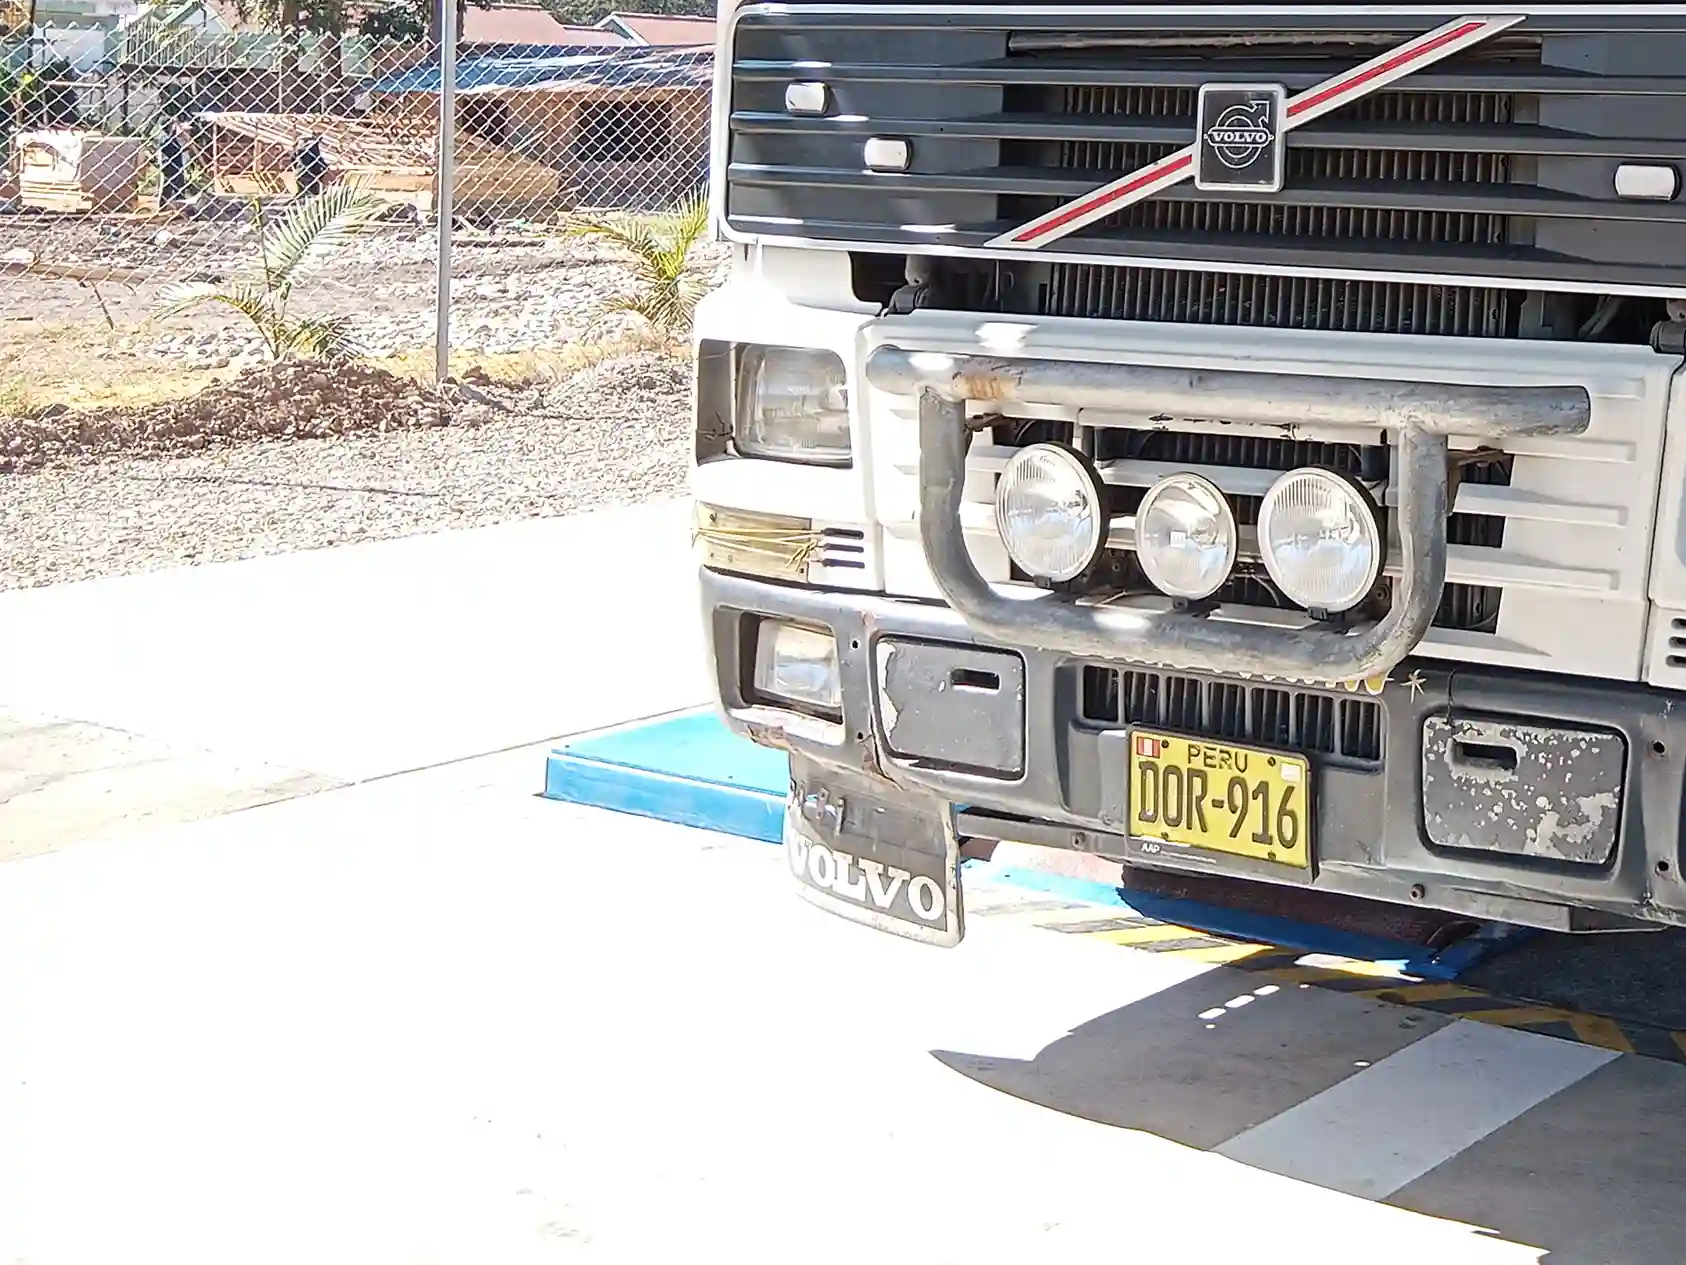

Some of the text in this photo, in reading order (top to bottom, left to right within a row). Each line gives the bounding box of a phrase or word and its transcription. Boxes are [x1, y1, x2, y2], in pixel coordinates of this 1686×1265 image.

[1211, 131, 1267, 143] VOLVO
[1187, 744, 1248, 774] PERU
[1138, 760, 1298, 850] DOR-916
[788, 833, 945, 922] VOLVO
